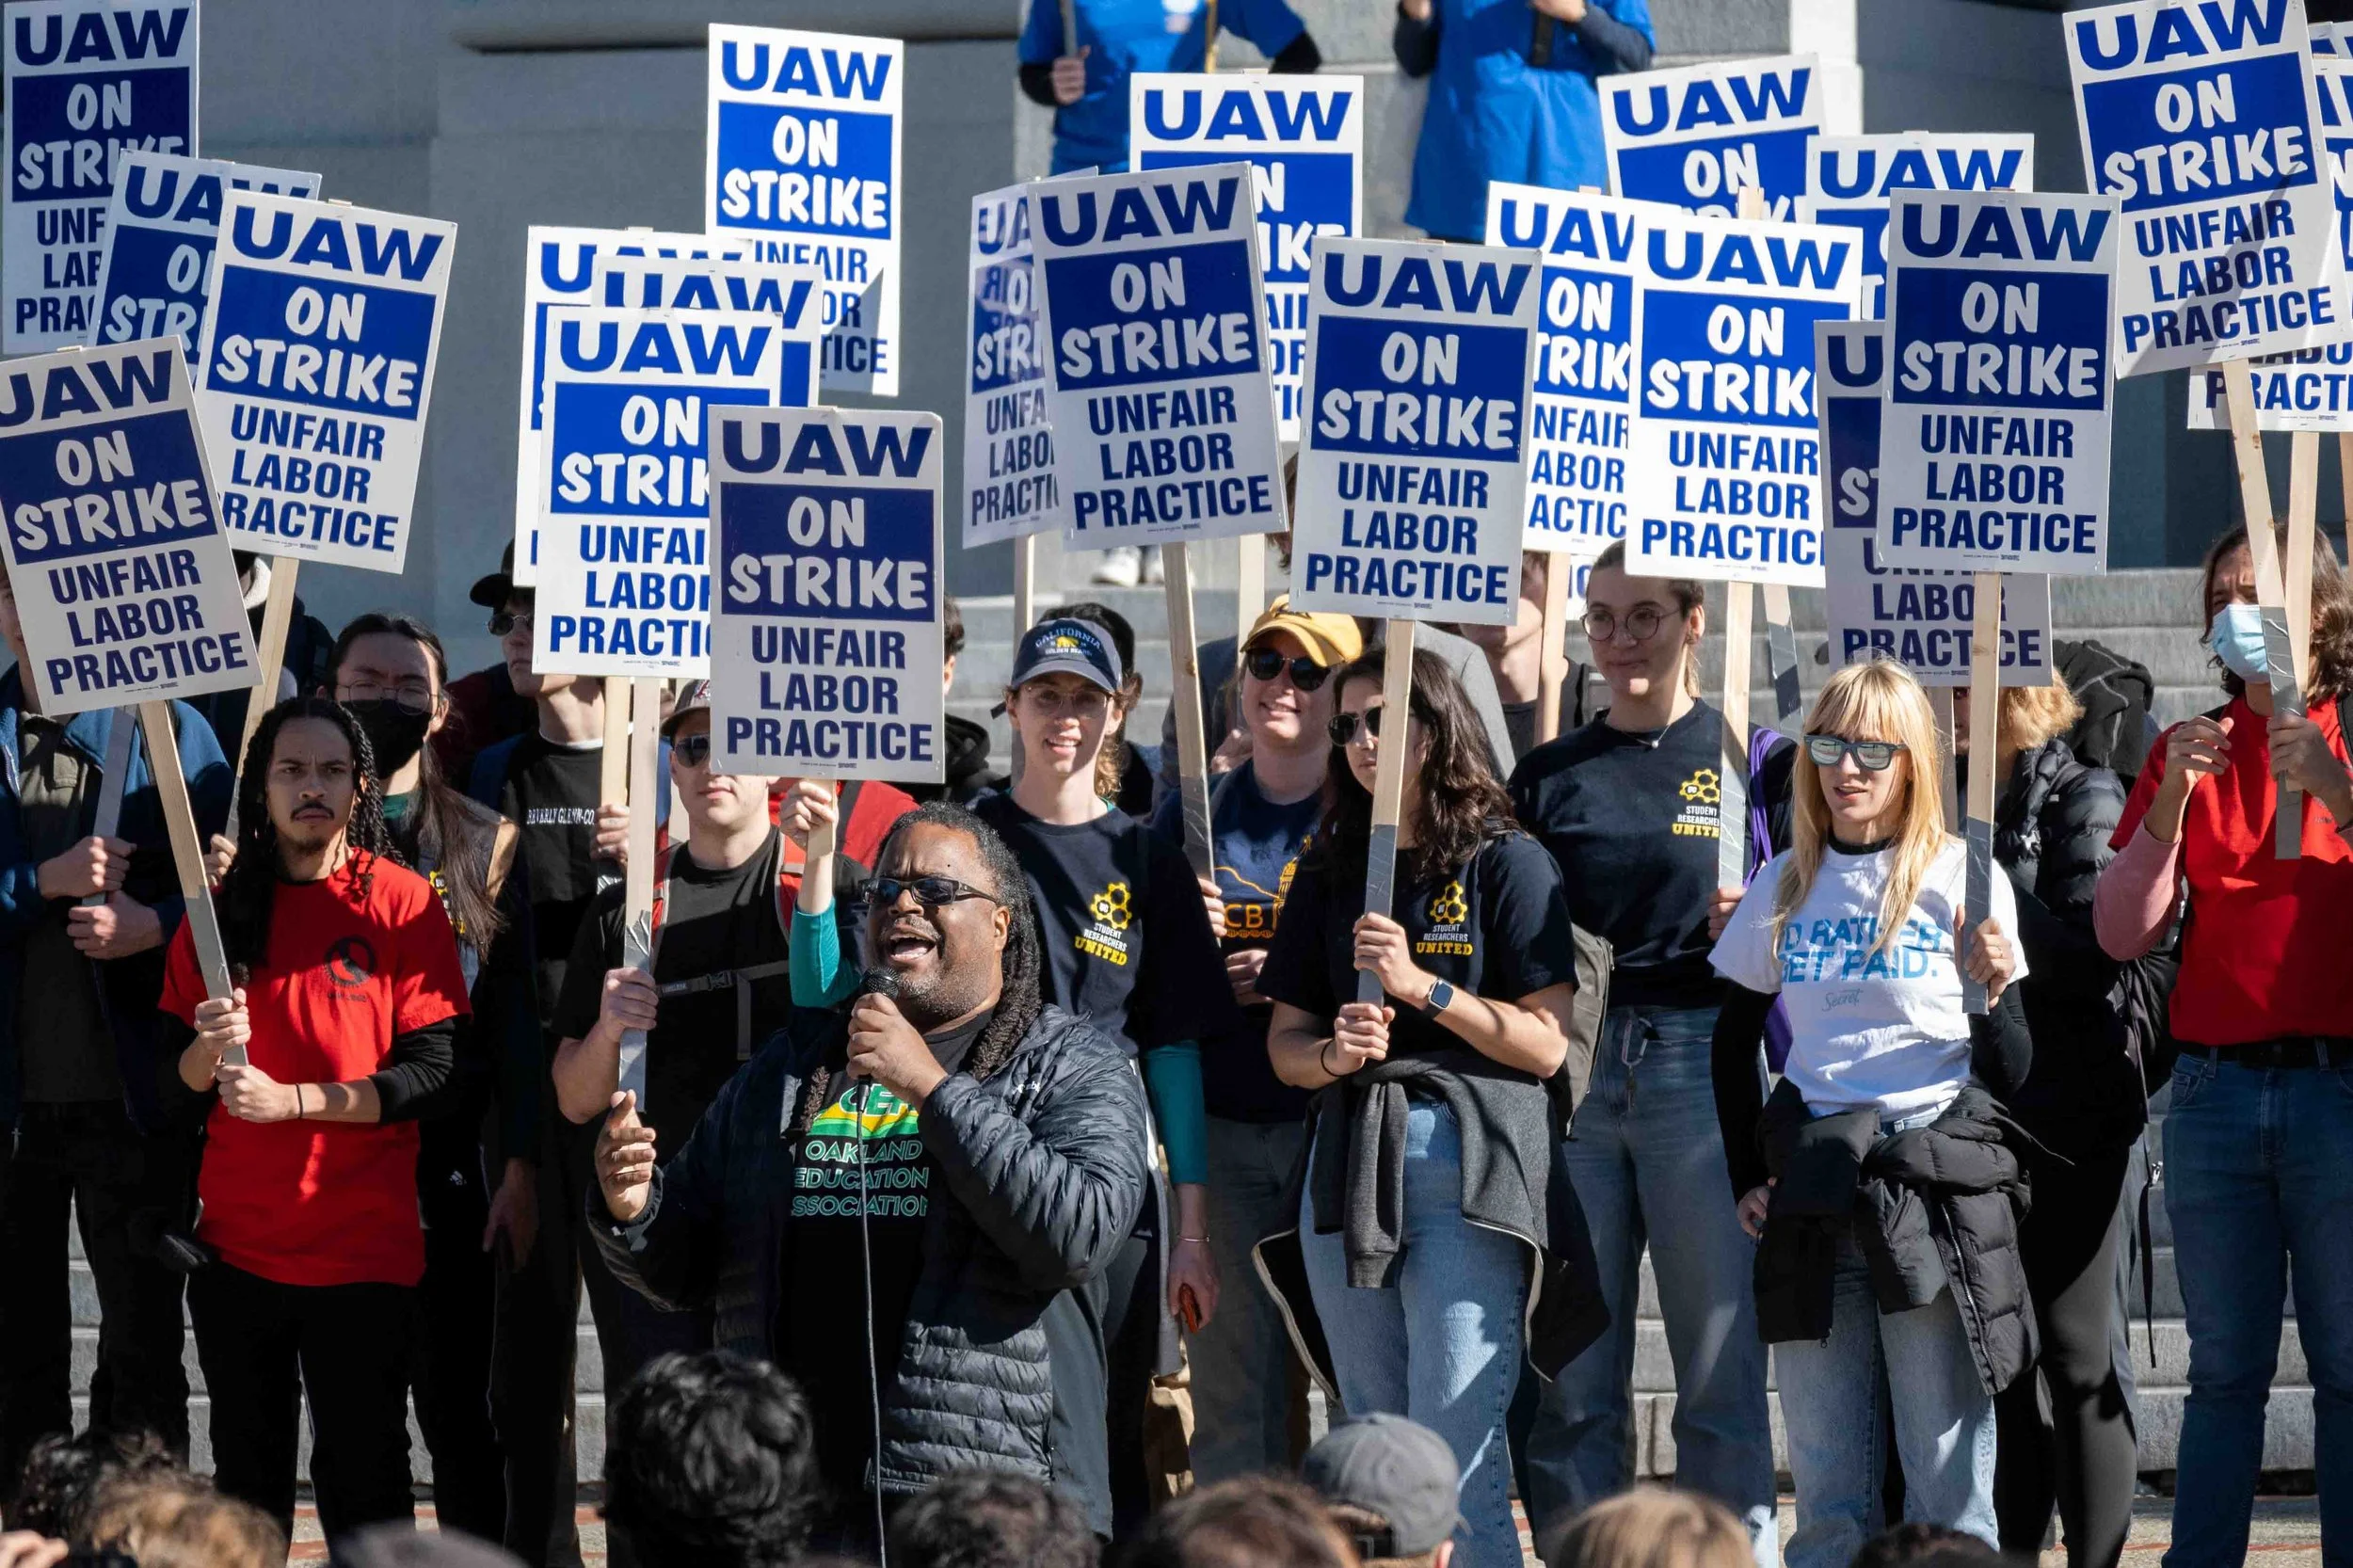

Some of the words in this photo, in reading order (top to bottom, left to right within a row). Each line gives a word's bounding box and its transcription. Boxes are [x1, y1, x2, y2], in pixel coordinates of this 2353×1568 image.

[14, 8, 189, 66] UAW
[2075, 0, 2290, 72] UAW
[722, 40, 893, 102] UAW
[67, 80, 132, 131] ON
[1144, 89, 1353, 141] UAW
[1612, 67, 1812, 136] UAW
[2155, 73, 2236, 133] ON
[773, 115, 839, 168] ON
[2104, 125, 2309, 201] STRIKE
[125, 165, 310, 227] UA
[1253, 161, 1286, 214] N
[1683, 142, 1760, 198] ON
[1819, 149, 2025, 199] UAW
[721, 168, 888, 230] STRIKE
[1040, 177, 1240, 247] UAW
[232, 204, 444, 282] UAW
[1902, 203, 2111, 263] UAW
[2135, 199, 2296, 258] UNFAIR
[1111, 256, 1186, 312] ON
[1323, 252, 1533, 315] UAW
[1647, 229, 1851, 290] UAW
[2149, 247, 2294, 303] LABOR
[16, 295, 95, 334] PRA
[105, 294, 208, 353] STR
[284, 285, 366, 343] ON
[1546, 277, 1613, 332] ON
[1706, 304, 1785, 357] ON
[1961, 281, 2040, 335] ON
[2122, 285, 2336, 354] PRACTICE
[216, 334, 418, 408] STRIKE
[560, 320, 772, 376] UAW
[1061, 312, 1252, 377] STRIKE
[1381, 330, 1460, 386] ON
[1899, 340, 2100, 398] STRIKE
[1088, 386, 1238, 436] UNFAIR
[1646, 358, 1818, 417] STRIK
[231, 404, 386, 461] UNFAIR
[620, 394, 700, 446] ON
[1318, 388, 1516, 450] STRIKE
[1920, 414, 2074, 459] UNFAIR
[56, 430, 135, 486] ON
[231, 449, 371, 504] LABOR
[723, 421, 933, 478] UAW
[989, 430, 1054, 479] LABO
[1099, 433, 1235, 481] LABOR
[1669, 430, 1817, 476] UNFAIR
[558, 452, 709, 506] STRI
[971, 472, 1060, 527] PRACTI
[1073, 474, 1273, 530] PRACTICE
[1337, 461, 1489, 509] UNFAIR
[1675, 476, 1810, 520] LABOR
[1926, 461, 2065, 506] LABOR
[14, 479, 207, 551] STRIKE
[217, 490, 399, 552] RACTICE
[787, 496, 865, 548] ON
[1341, 509, 1478, 555] LABOR
[1891, 507, 2098, 554] PRACTICE
[1641, 519, 1826, 567] PRACTIC
[48, 549, 201, 605] UNFAIR
[728, 553, 928, 610] STRIKE
[1305, 553, 1510, 604] PRACTICE
[66, 594, 204, 648] LABOR
[550, 615, 710, 657] PRACTI
[752, 625, 905, 669] UNFAIR
[1035, 628, 1102, 648] CALIFORNIA
[1842, 629, 2041, 667] PRACTCE
[46, 632, 248, 696] PRACTICE
[760, 671, 899, 715] LABOR
[727, 716, 933, 761] PRACTICE
[1074, 935, 1128, 966] UNITED
[1082, 928, 1128, 952] RESEARCHERS
[1093, 922, 1122, 939] STUDENT
[1416, 941, 1474, 956] UNITED
[1423, 933, 1468, 942] RESEARCHERS
[1433, 923, 1461, 933] STUDENT
[1810, 917, 1943, 951] RATER
[1842, 945, 1938, 981] PAID.
[1822, 988, 1865, 1012] Secret
[793, 1167, 930, 1190] EDUCATION
[806, 1140, 923, 1164] OAKLAND
[792, 1194, 929, 1217] SSOCIATIO
